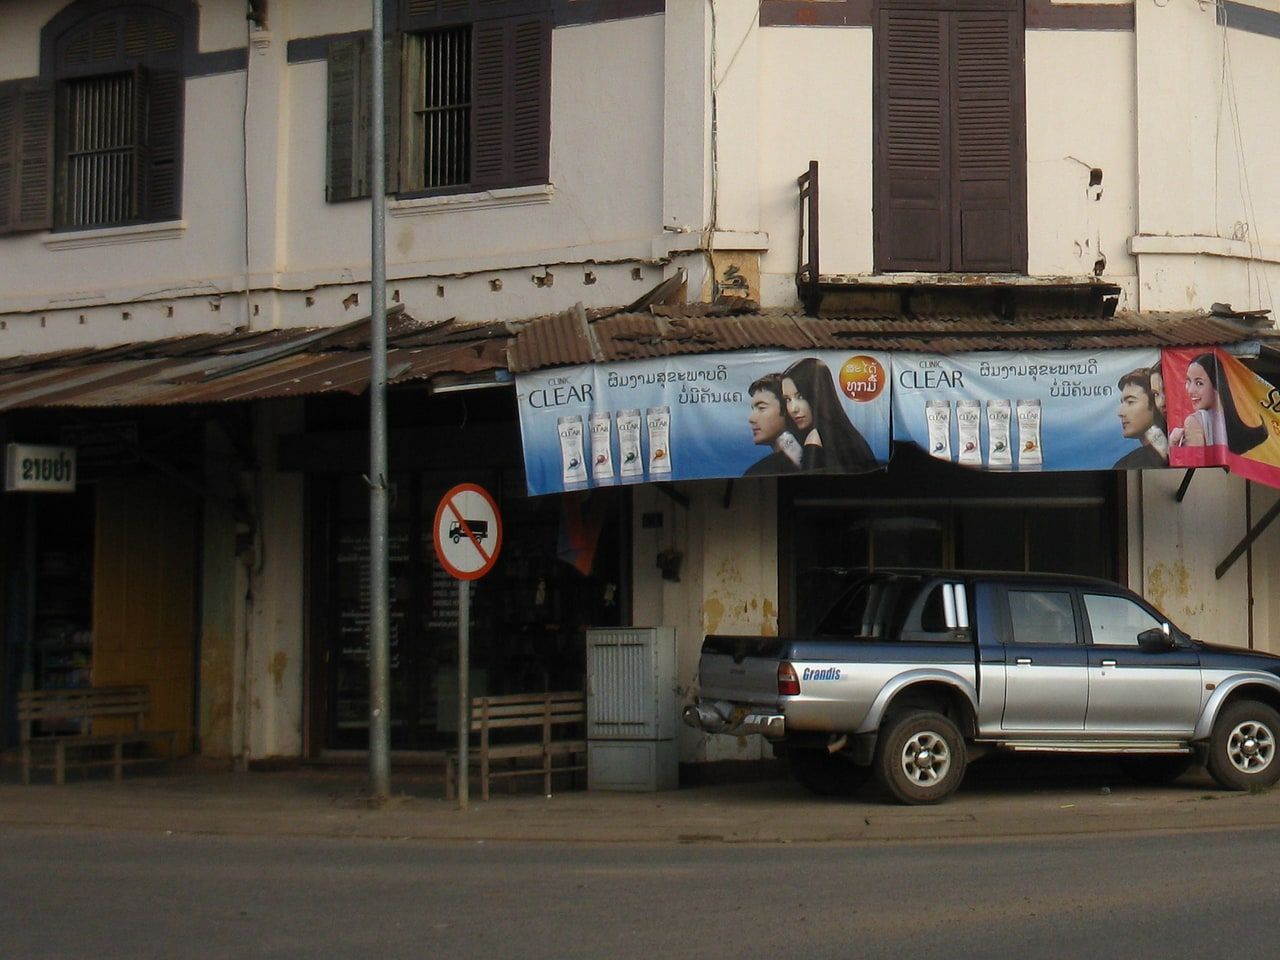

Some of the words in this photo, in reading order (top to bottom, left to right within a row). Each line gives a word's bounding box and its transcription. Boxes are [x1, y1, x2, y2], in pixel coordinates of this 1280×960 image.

[899, 370, 965, 390] CLEAR
[528, 383, 595, 409] CLEAR
[802, 667, 842, 681] Grandis
